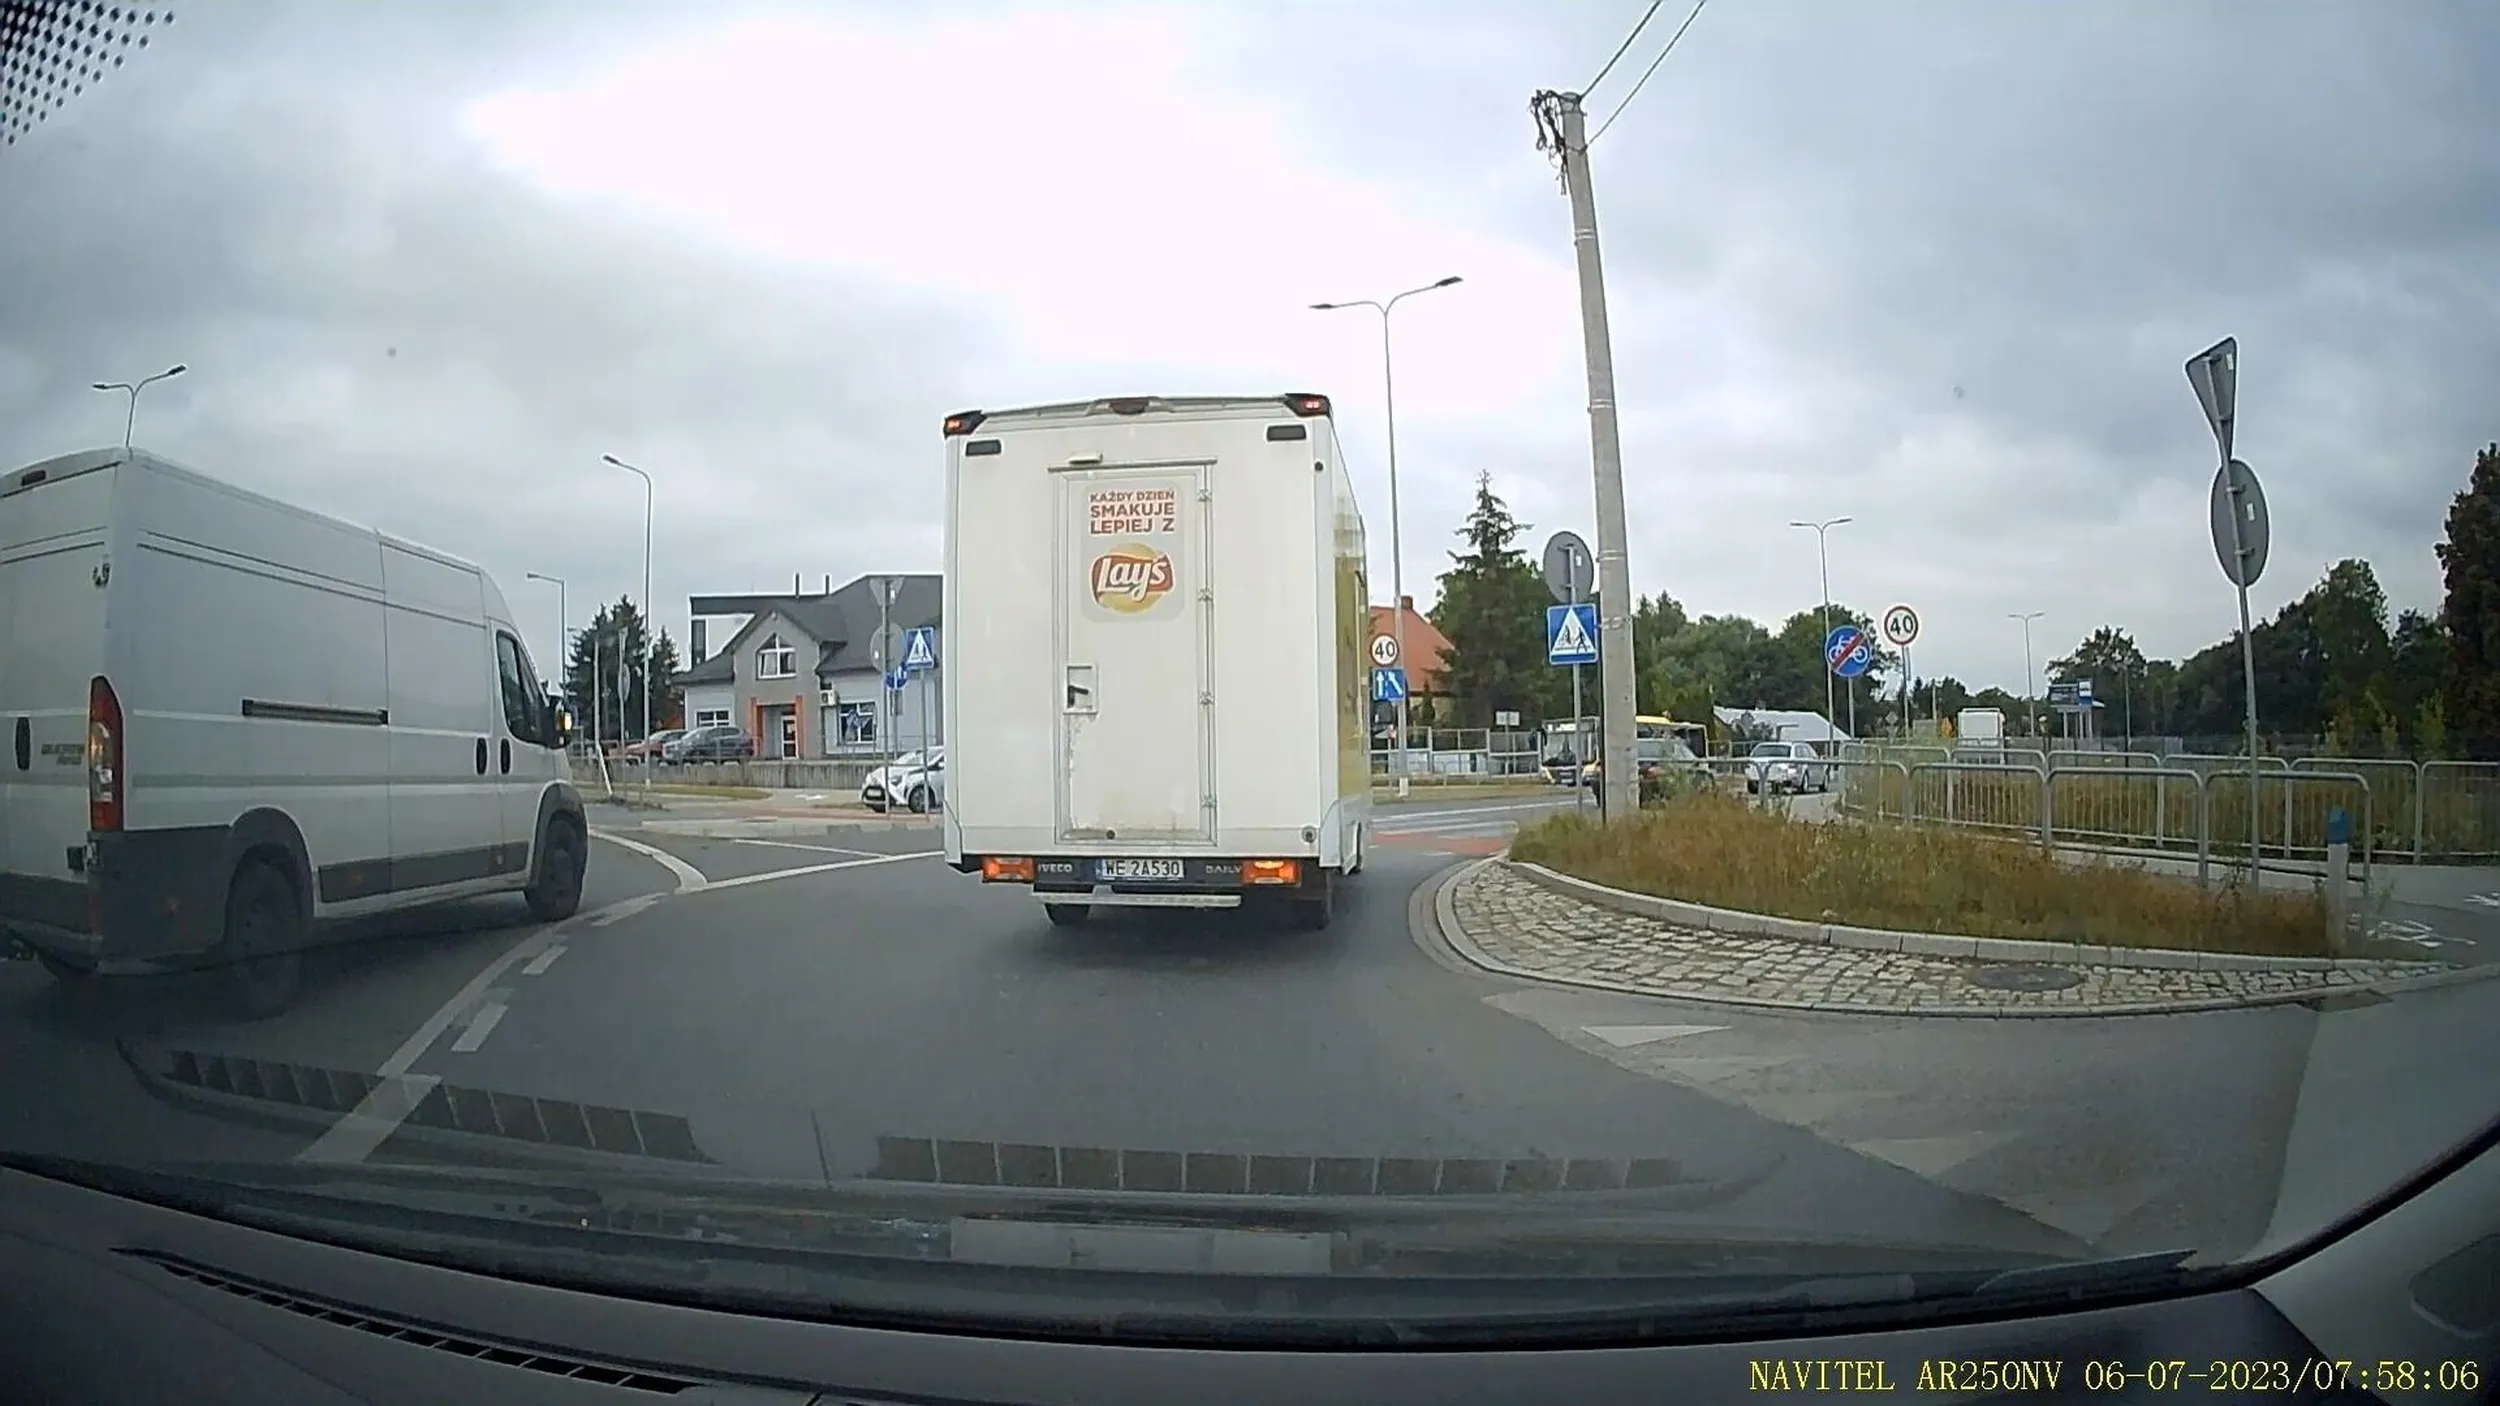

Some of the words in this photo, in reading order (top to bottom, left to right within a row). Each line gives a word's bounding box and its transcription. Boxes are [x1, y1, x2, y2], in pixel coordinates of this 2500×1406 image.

[1090, 491, 1133, 502] KAŻDY
[1136, 488, 1174, 501] DZIEŃ
[1090, 502, 1175, 518] SMAKUJE
[1090, 519, 1153, 534] LEPIEJ
[1162, 518, 1175, 532] Z
[1890, 615, 1914, 635] 40
[1375, 641, 1395, 659] 40
[1038, 863, 1073, 873] IVECO
[1106, 860, 1126, 876] WE
[1131, 861, 1181, 876] 2A530
[1205, 865, 1241, 874] DAILY
